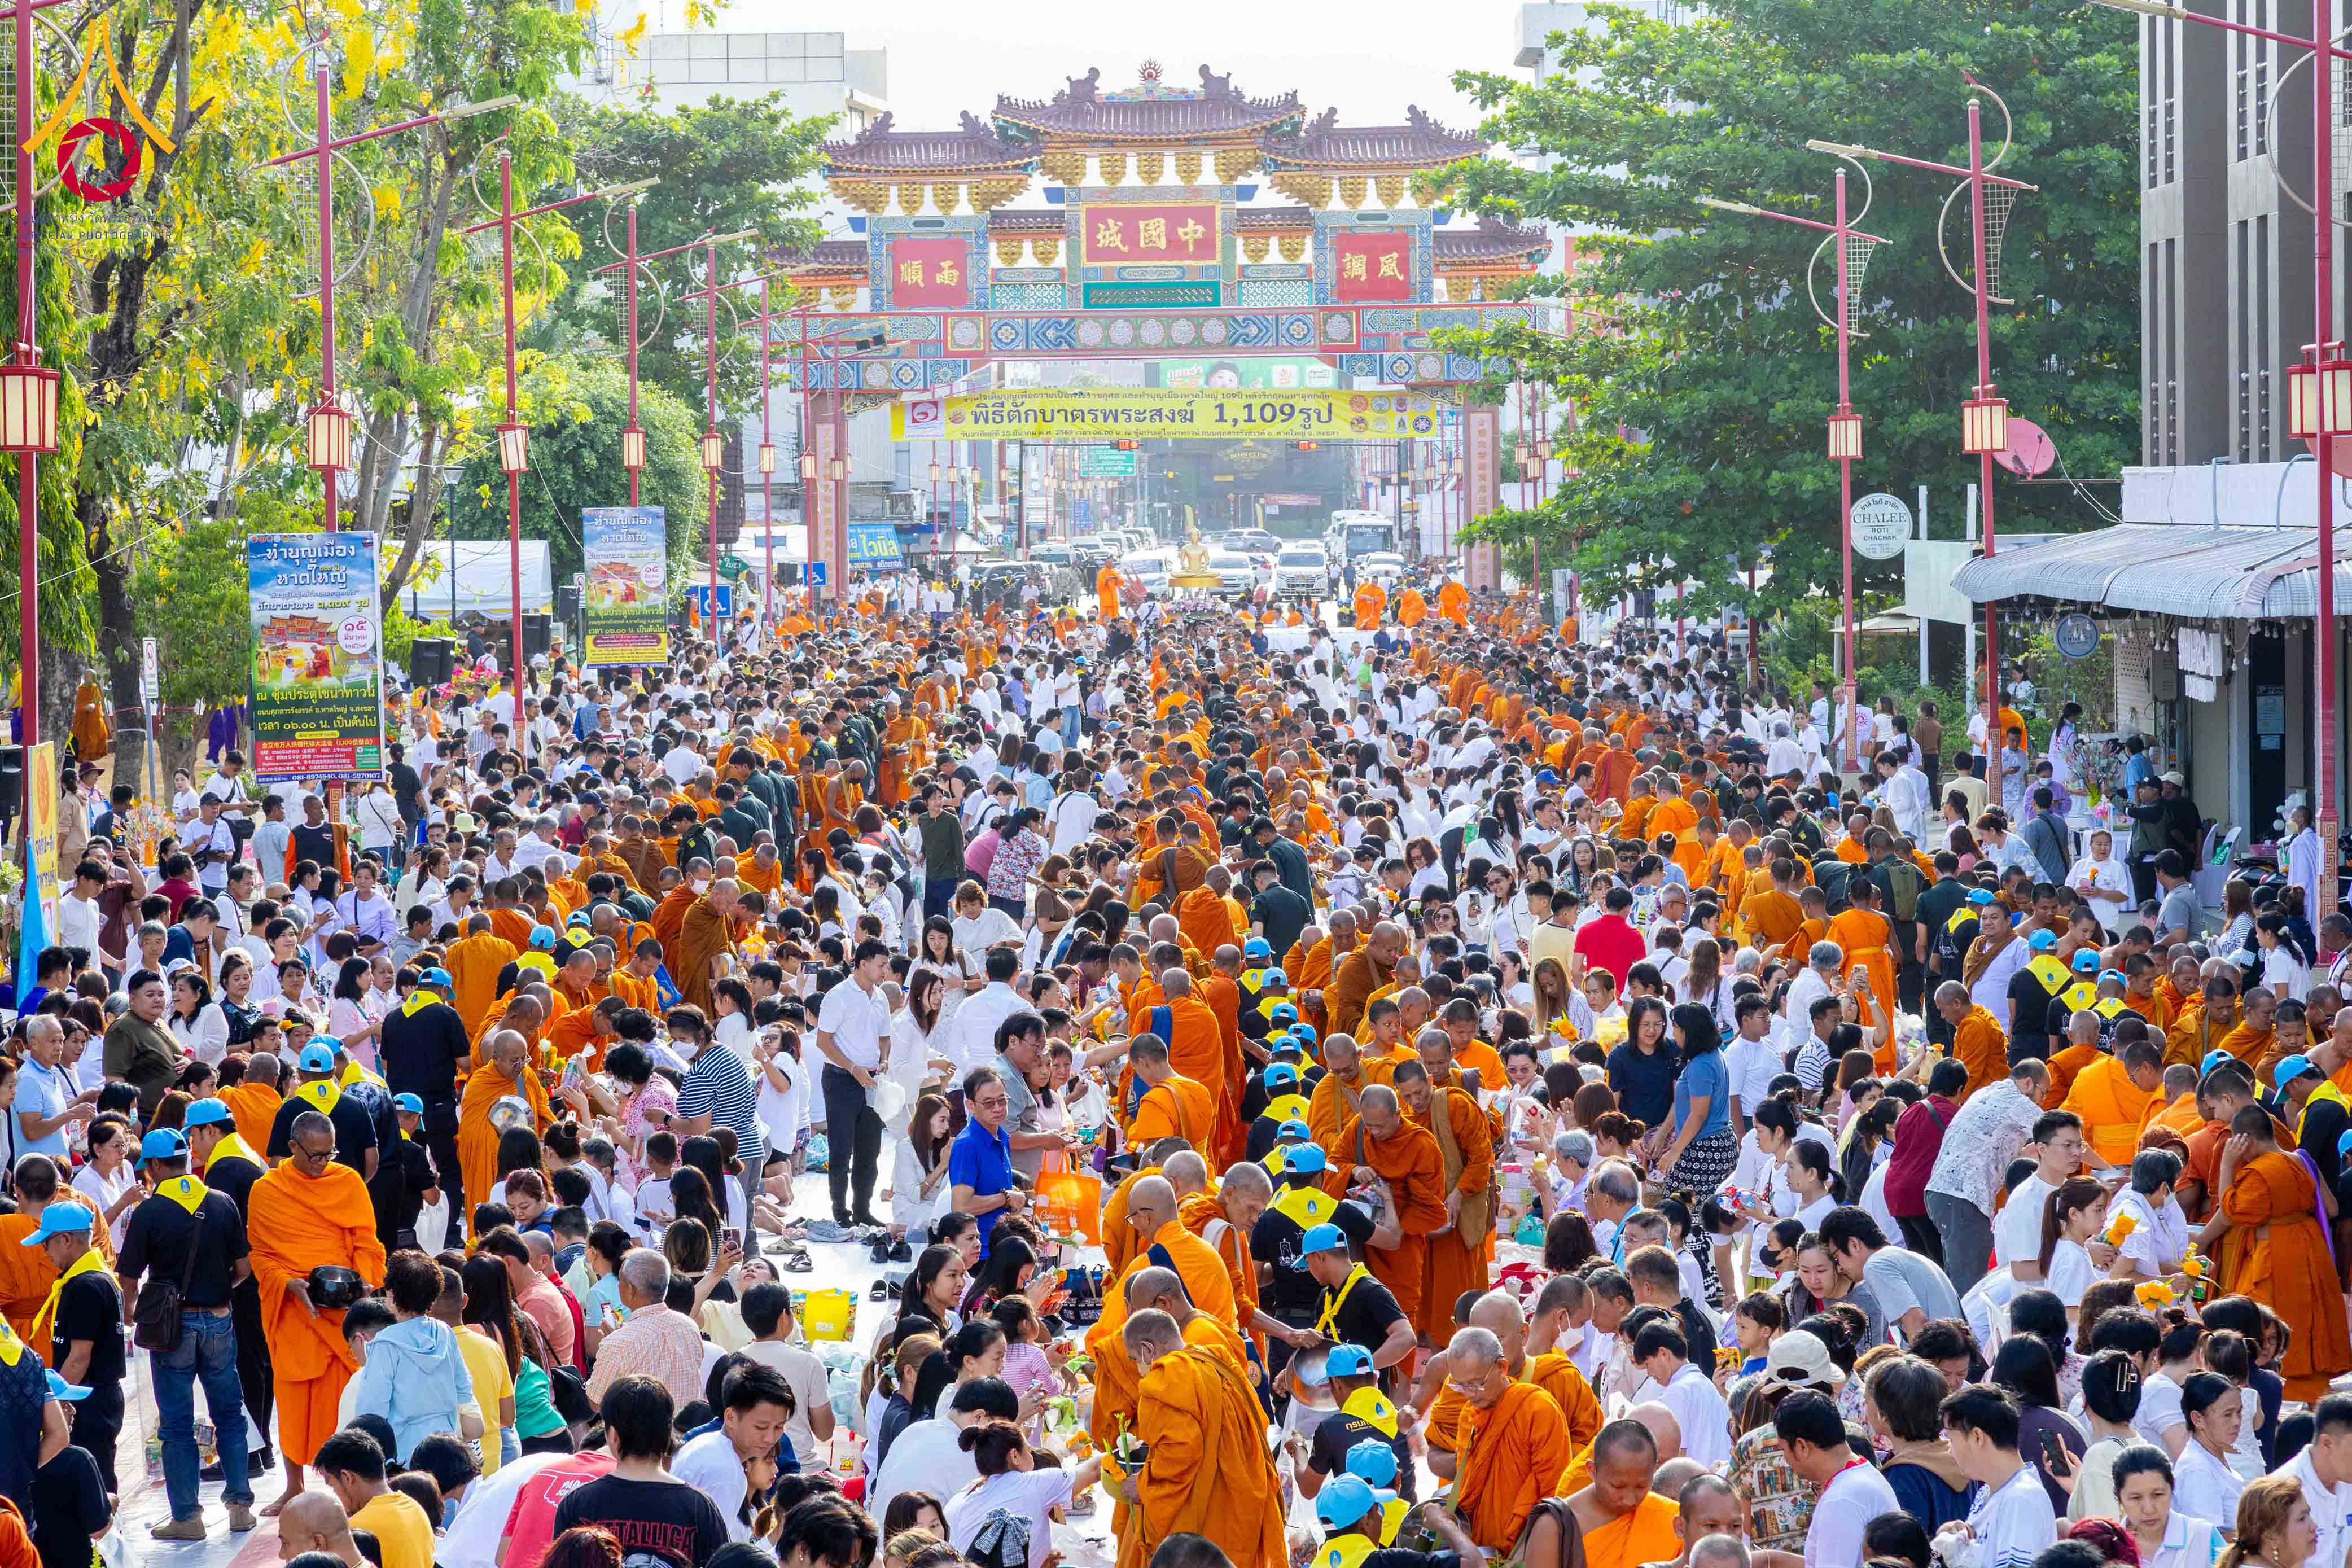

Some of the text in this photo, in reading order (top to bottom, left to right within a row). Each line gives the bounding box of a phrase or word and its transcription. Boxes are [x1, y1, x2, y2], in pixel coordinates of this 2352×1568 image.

[971, 399, 1195, 424] พิธีตักบาตรพระสงฆ์
[1853, 513, 1906, 524] CHALEE
[266, 540, 356, 567] ทำบุญเมือง
[277, 564, 348, 589] หาดใหญ่
[344, 620, 367, 632] ๑๕
[258, 721, 280, 732] เวลา
